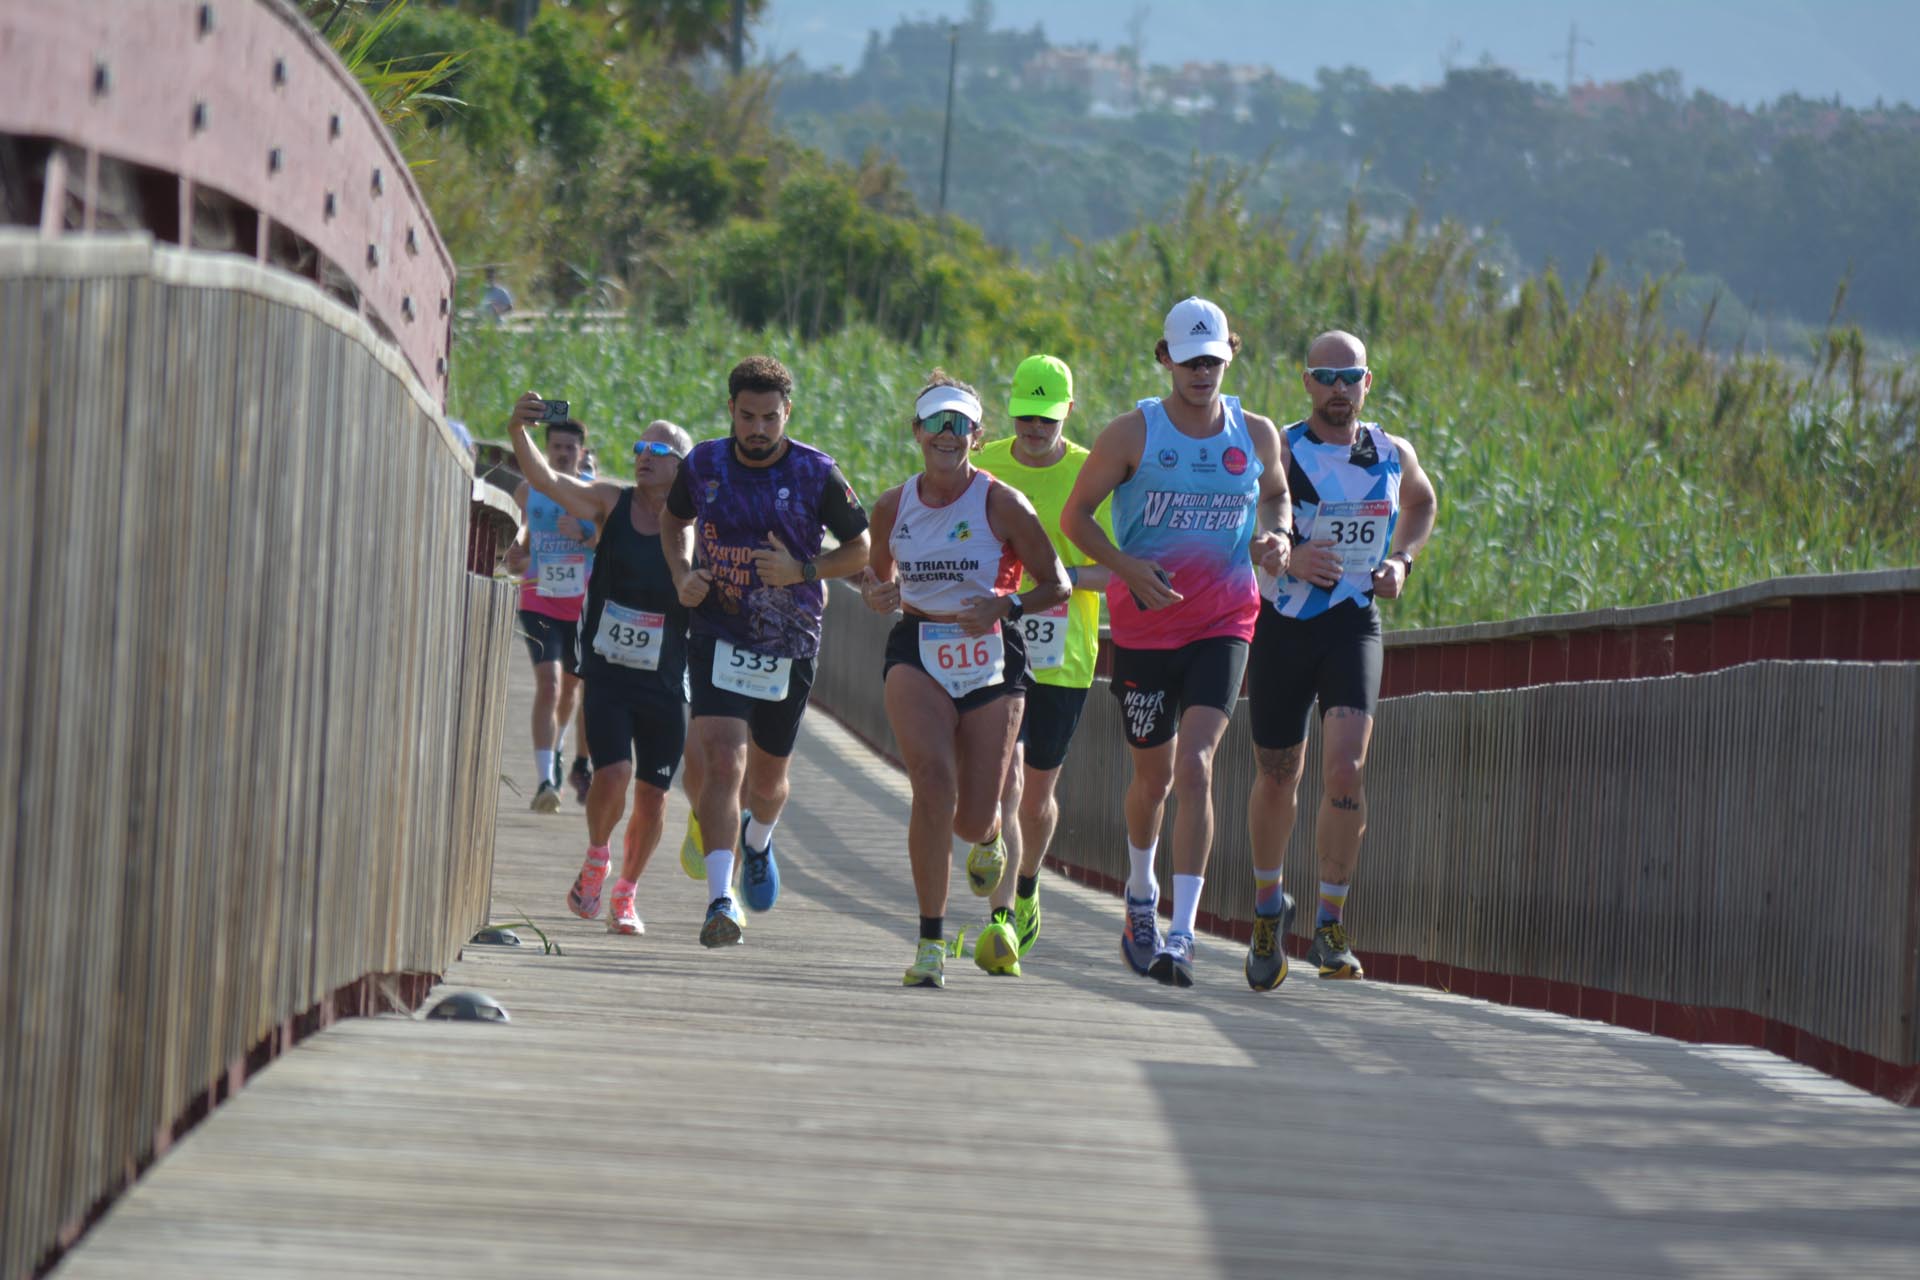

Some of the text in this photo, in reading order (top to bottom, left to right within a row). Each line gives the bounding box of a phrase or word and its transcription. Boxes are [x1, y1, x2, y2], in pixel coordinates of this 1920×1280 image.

[1171, 493, 1207, 507] MEDIA
[1211, 494, 1255, 508] MARA
[1167, 510, 1244, 529] ESTEPO
[1330, 521, 1375, 544] 336
[545, 566, 576, 582] 554
[915, 558, 979, 571] TRIATLÓN
[609, 623, 650, 648] 439
[730, 645, 778, 673] 533
[937, 641, 989, 669] 616
[1124, 690, 1165, 714] NEVER
[1127, 706, 1157, 725] GIVE
[1132, 722, 1154, 737] UP
